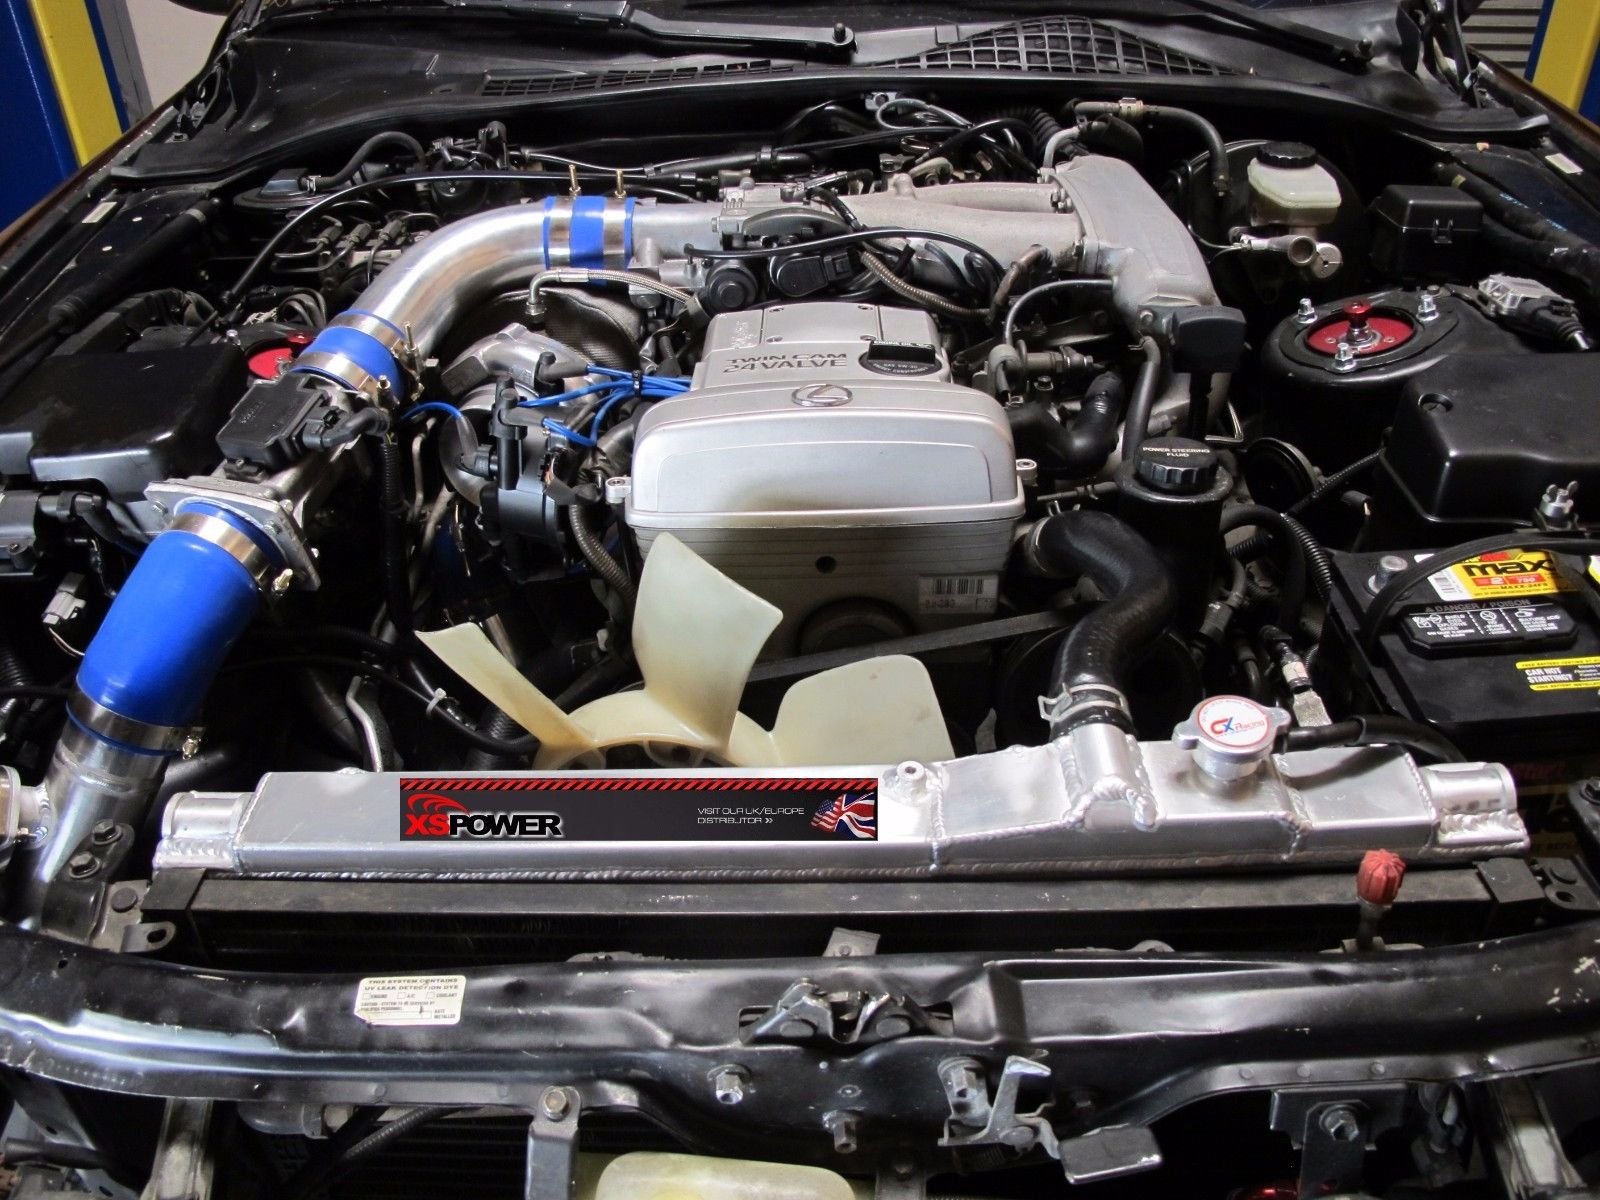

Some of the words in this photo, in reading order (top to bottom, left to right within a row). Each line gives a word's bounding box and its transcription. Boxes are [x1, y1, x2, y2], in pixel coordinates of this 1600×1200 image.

[727, 354, 786, 364] TWIN
[1434, 602, 1480, 612] DANGER
[1489, 598, 1531, 609] POISON
[1524, 668, 1544, 676] CAR
